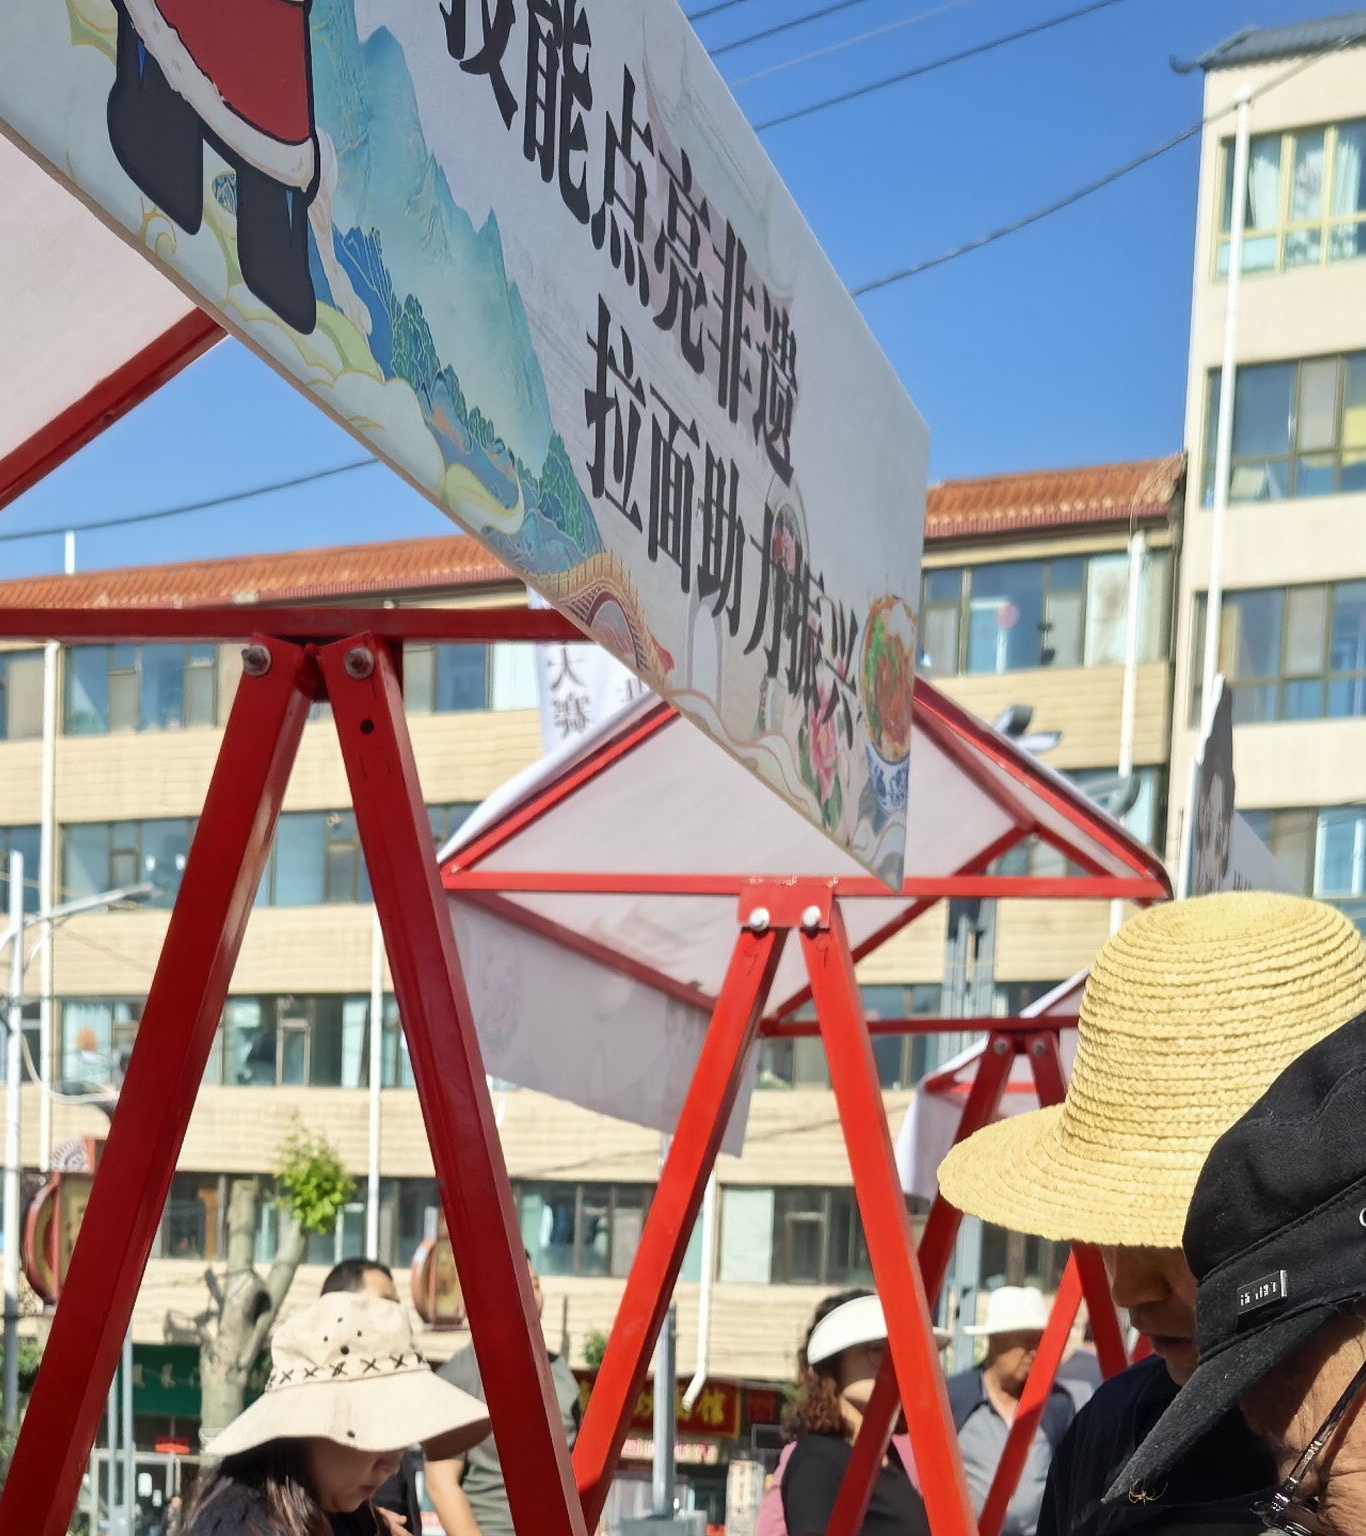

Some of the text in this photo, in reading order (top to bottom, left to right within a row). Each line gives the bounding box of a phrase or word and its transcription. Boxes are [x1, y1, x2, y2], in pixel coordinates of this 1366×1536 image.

[585, 293, 858, 749] 拉面助力振兴
